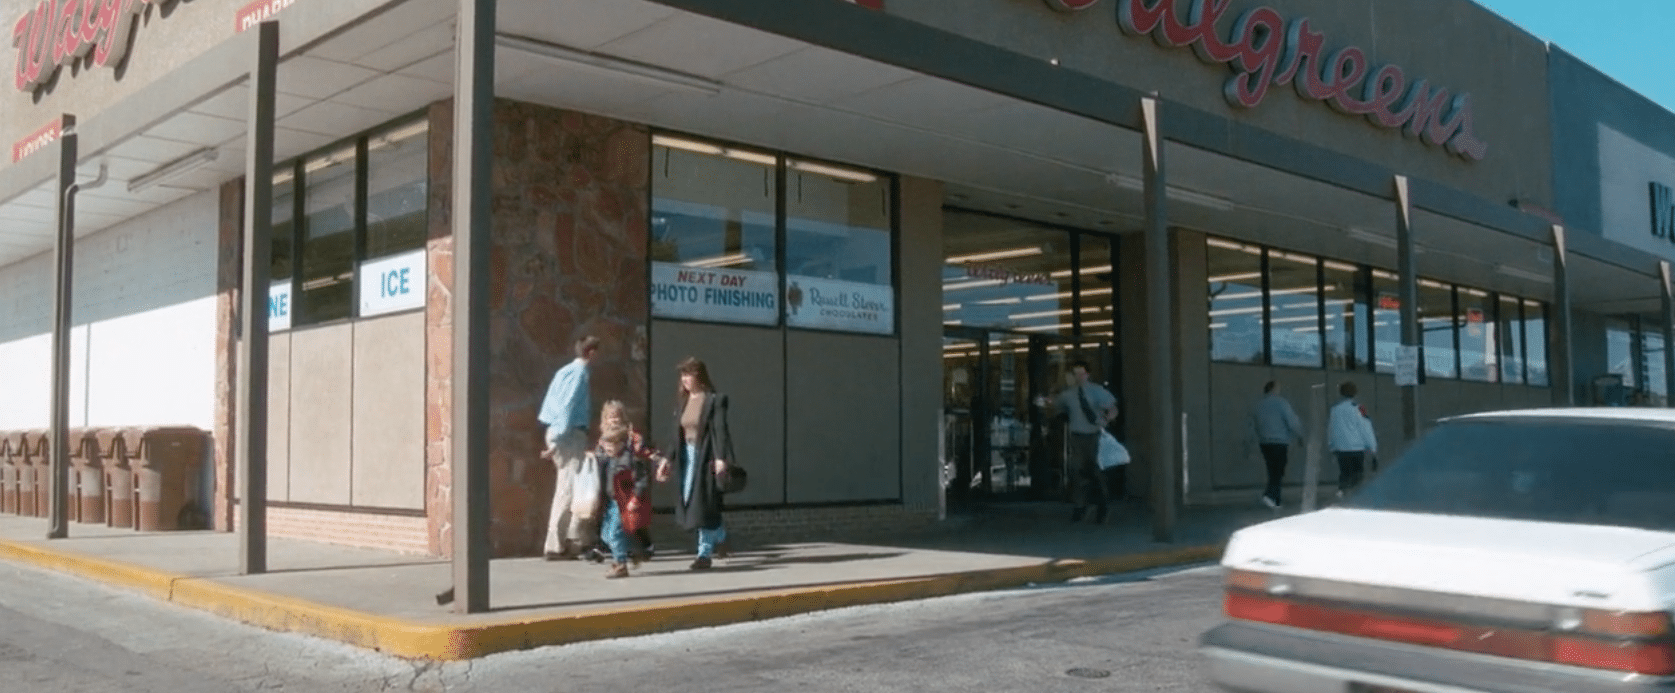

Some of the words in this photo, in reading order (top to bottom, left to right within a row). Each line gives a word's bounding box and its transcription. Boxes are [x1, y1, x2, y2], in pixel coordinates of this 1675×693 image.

[1055, 0, 1488, 161] algreens
[380, 266, 411, 299] ICE
[677, 270, 716, 285] NEXT
[720, 273, 747, 288] DAY
[268, 292, 288, 319] NE
[704, 287, 775, 309] FINISHING
